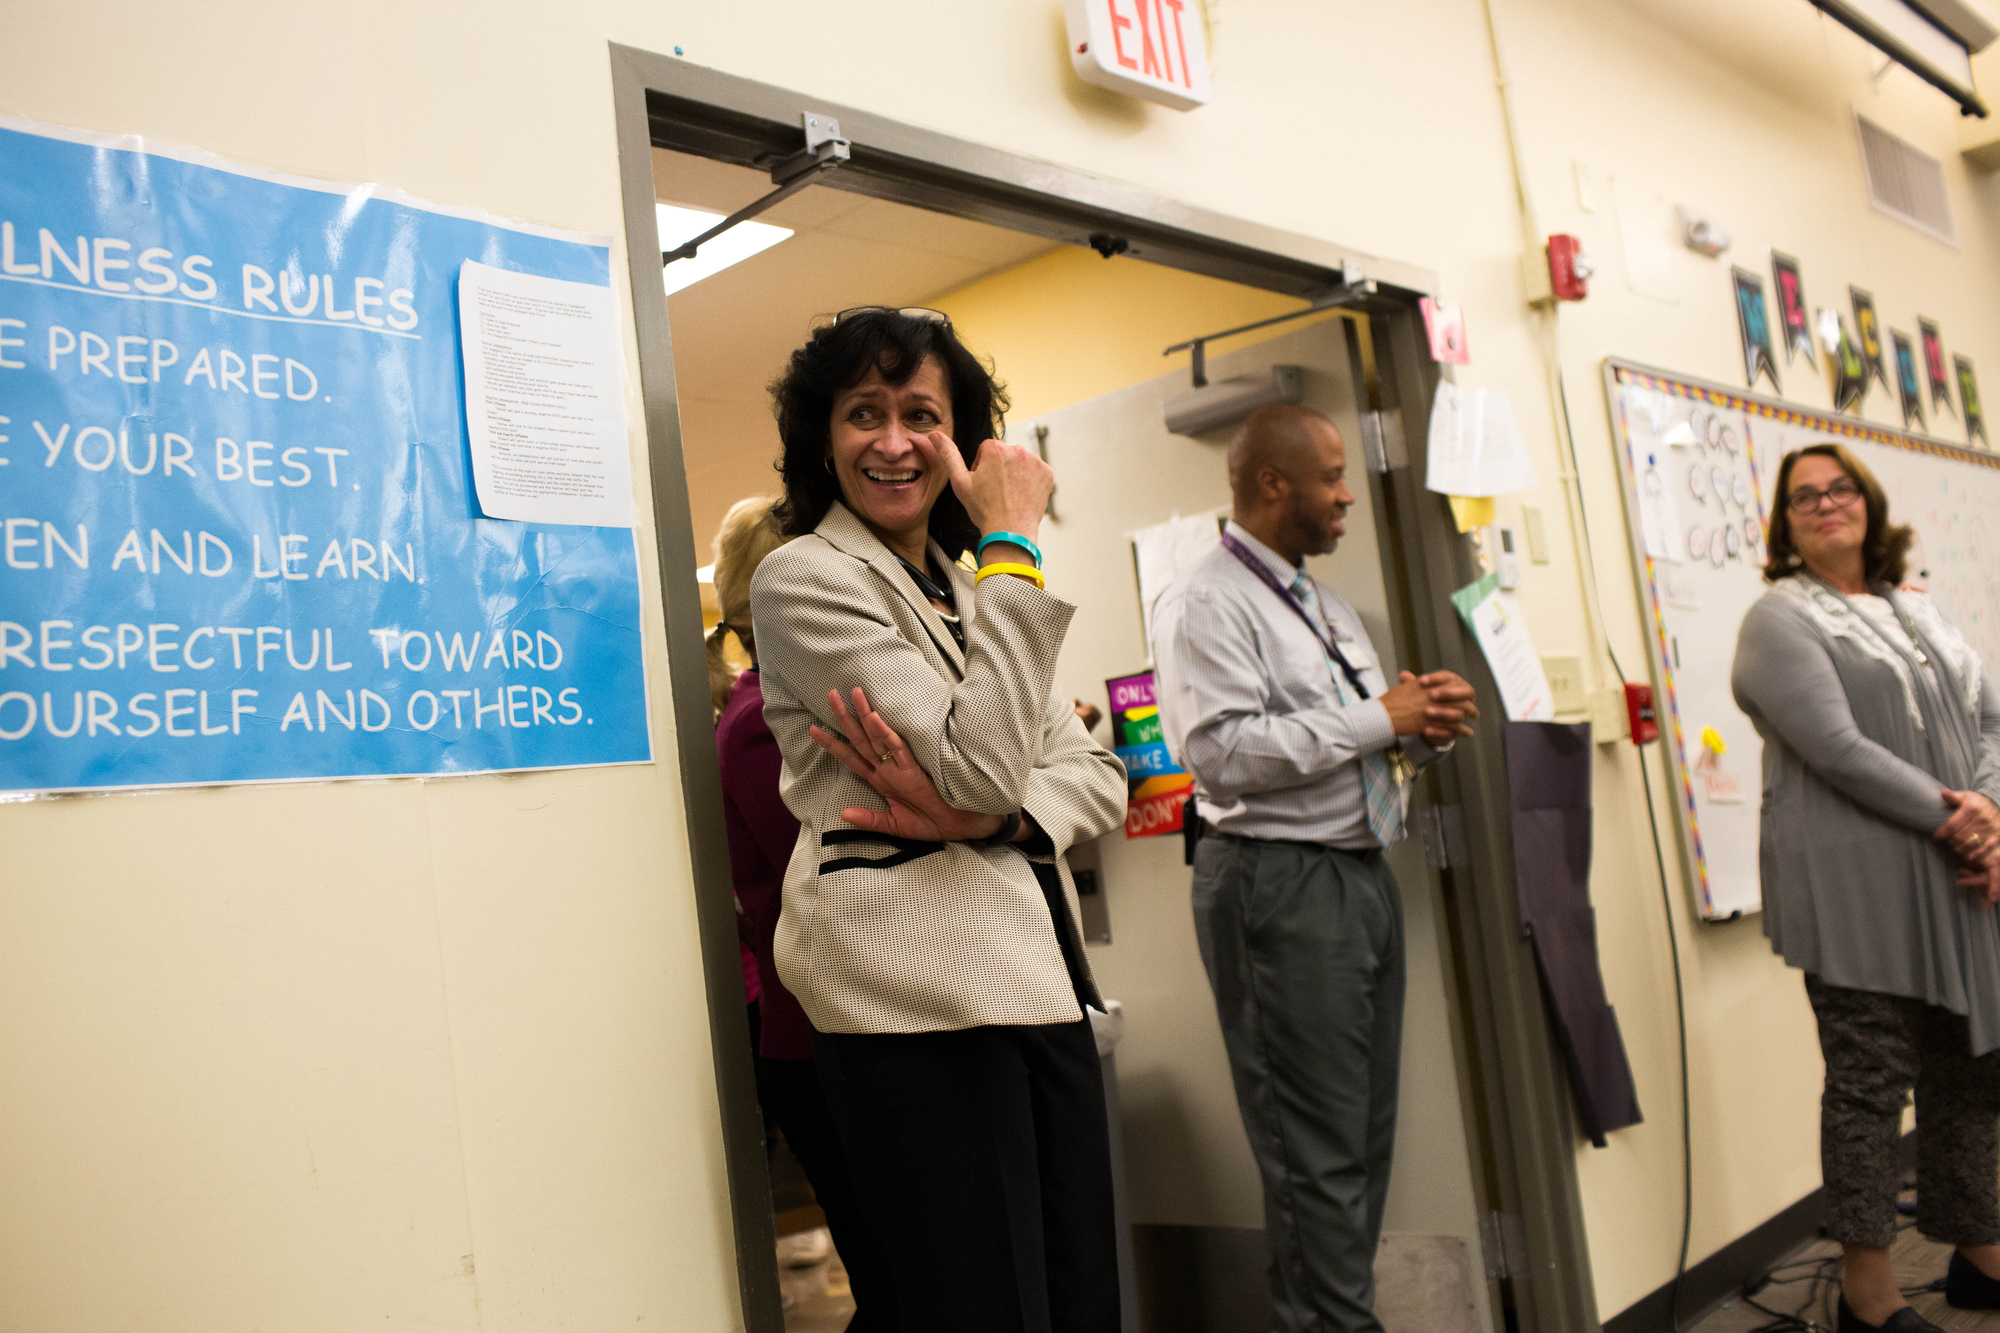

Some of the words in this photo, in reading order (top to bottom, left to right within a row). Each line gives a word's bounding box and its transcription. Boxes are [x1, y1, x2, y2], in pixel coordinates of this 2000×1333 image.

[1108, 0, 1193, 89] EXIT
[2, 221, 217, 300] LNESS
[242, 263, 419, 331] RULES
[49, 325, 332, 403] PREPARED.
[32, 420, 195, 478] YOUR
[216, 437, 360, 491] BEST.
[0, 518, 89, 569] EN
[111, 528, 233, 578] AND
[253, 534, 424, 584] LEARN.
[0, 620, 353, 672] RESPECTFUL
[368, 629, 563, 672] TOWARD
[0, 688, 259, 741] OURSELF
[280, 689, 392, 732] AND
[407, 685, 594, 731] OTHERS.
